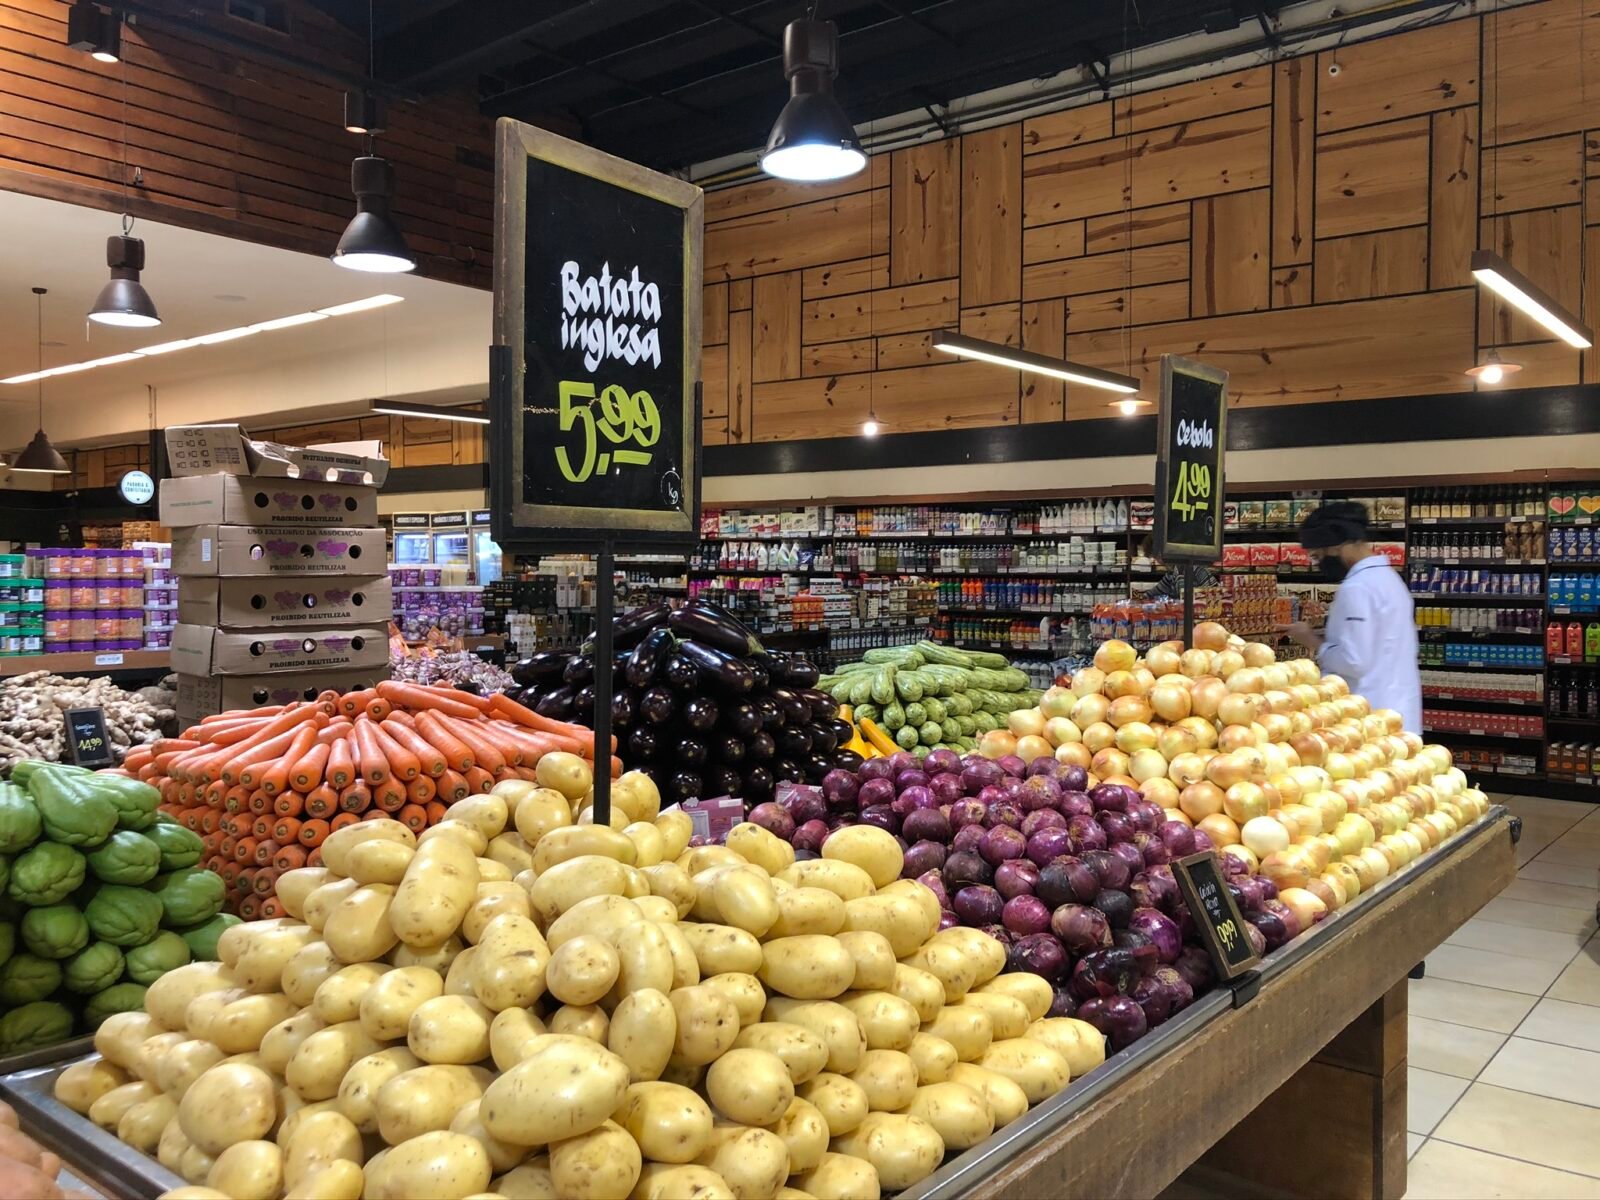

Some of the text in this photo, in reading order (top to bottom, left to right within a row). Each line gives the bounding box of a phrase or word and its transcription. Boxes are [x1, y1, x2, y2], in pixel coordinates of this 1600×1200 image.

[560, 260, 661, 323] Batata
[560, 312, 662, 373] inglesa
[554, 380, 662, 483] 5,99
[1176, 418, 1213, 450] Cebola
[1171, 461, 1211, 522] 4,99
[271, 515, 344, 523] PROIBIDO REUTILIZAR
[265, 528, 305, 536] EXCLUSIVO
[1223, 551, 1246, 561] Neve
[1252, 551, 1275, 561] Neve
[1281, 550, 1307, 561] Neve
[308, 612, 351, 620] REUTILIZAR
[269, 657, 350, 668] PROIBIDO REUTILIZAR
